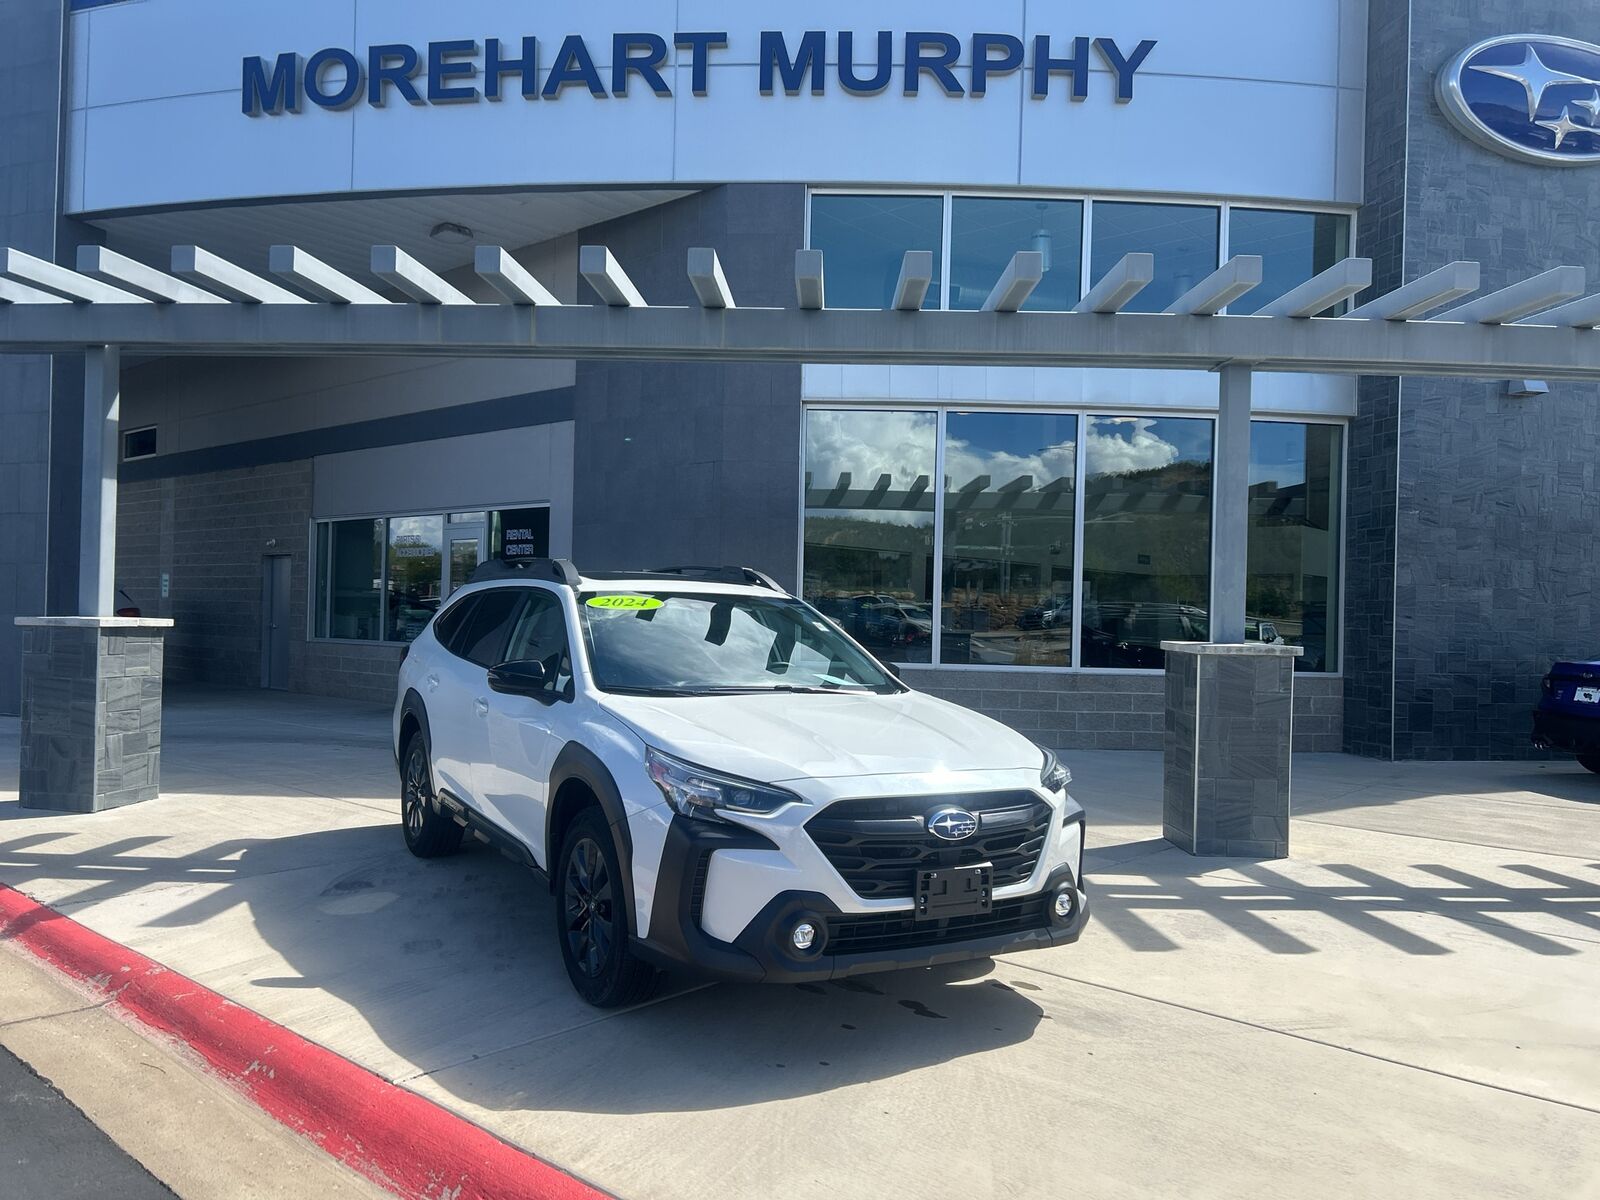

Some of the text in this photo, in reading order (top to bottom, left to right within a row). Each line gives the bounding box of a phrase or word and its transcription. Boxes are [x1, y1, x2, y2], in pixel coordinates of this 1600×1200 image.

[241, 31, 1158, 118] MOREHART MURPHY
[506, 529, 534, 540] RENTAL
[506, 544, 534, 555] CENTER
[600, 597, 649, 607] 2024
